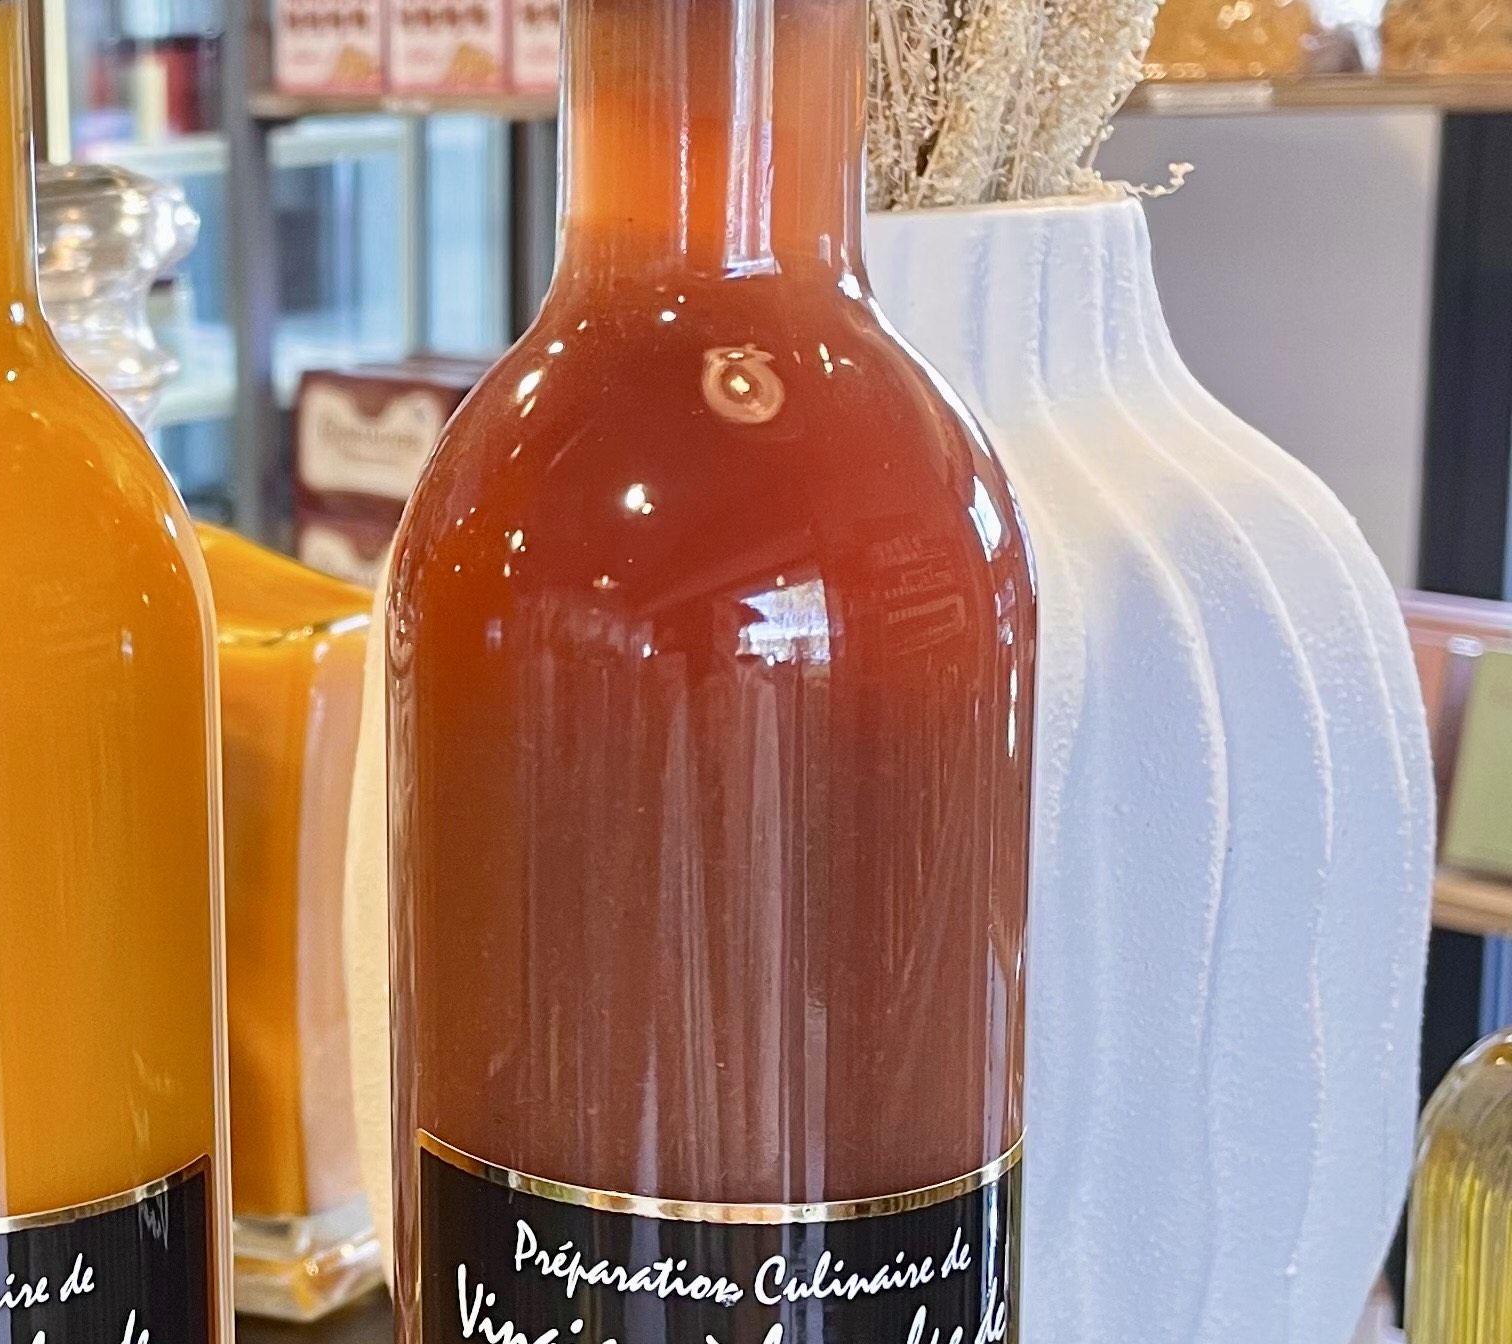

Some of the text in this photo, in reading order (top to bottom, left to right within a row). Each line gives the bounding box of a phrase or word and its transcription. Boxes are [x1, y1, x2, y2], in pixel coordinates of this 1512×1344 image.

[59, 1253, 95, 1301] de
[514, 1220, 973, 1308] Préparation Culinaire de
